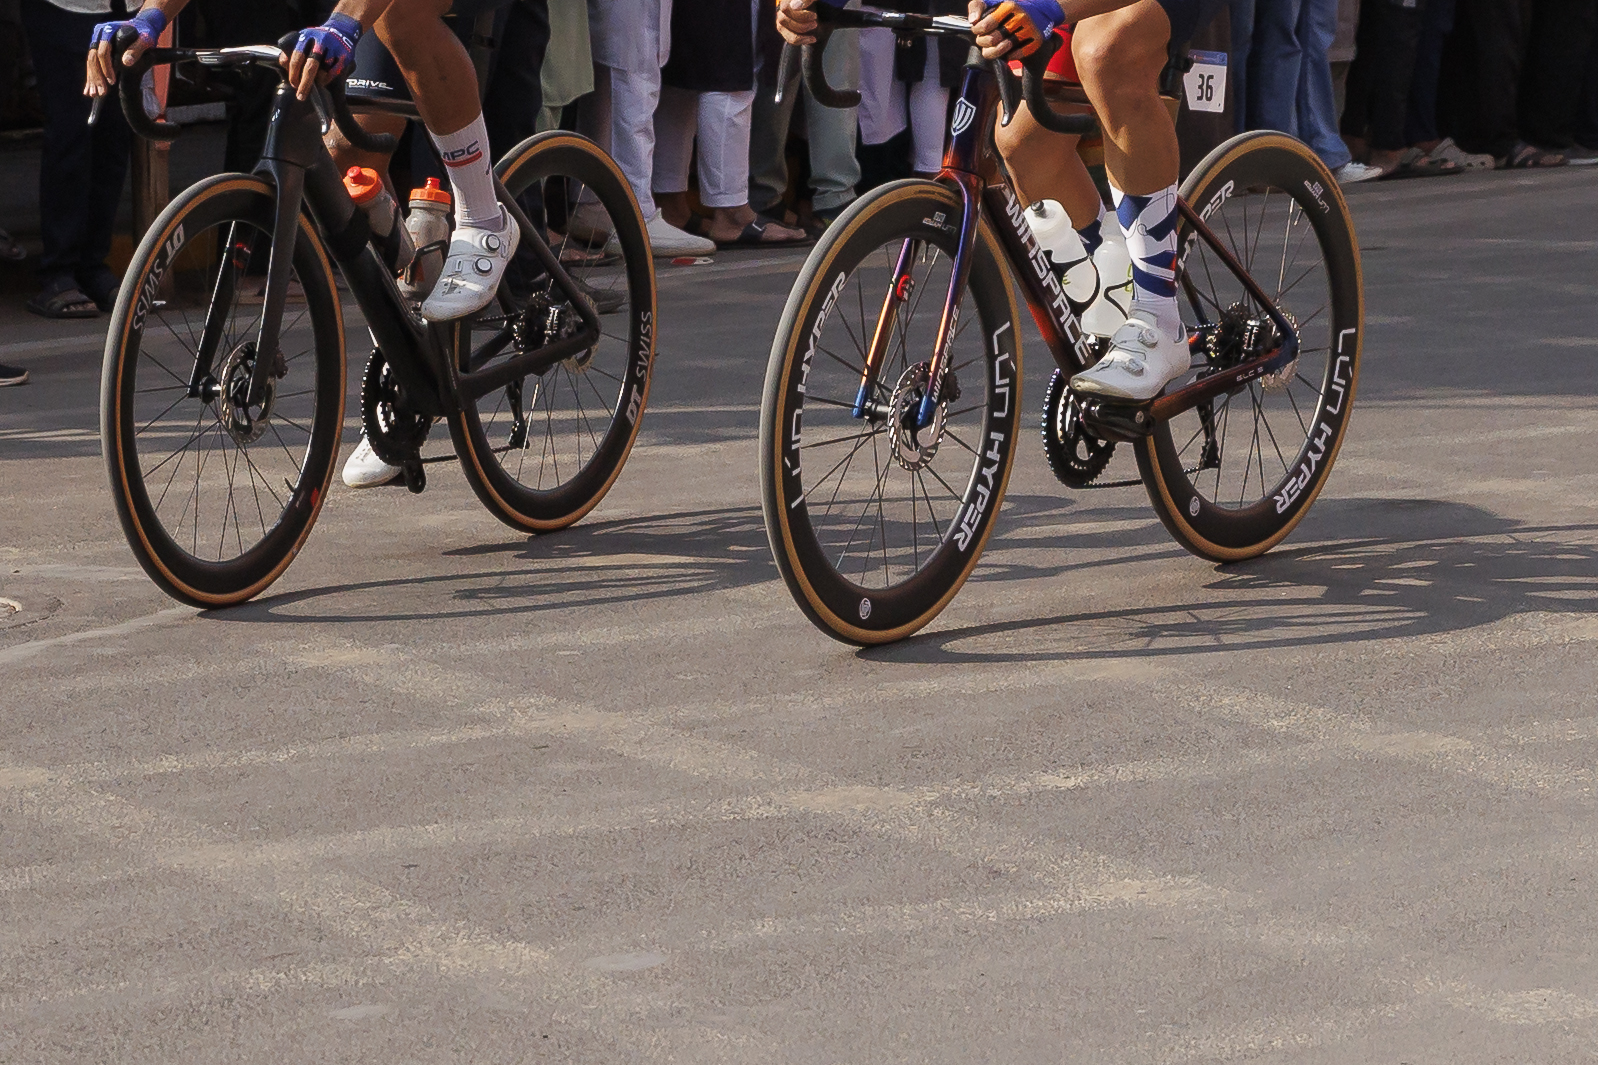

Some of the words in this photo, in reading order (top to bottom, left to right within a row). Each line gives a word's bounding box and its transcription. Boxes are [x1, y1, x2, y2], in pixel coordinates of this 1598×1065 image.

[1196, 73, 1215, 102] 36
[133, 258, 163, 331] SWISS
[165, 222, 185, 267] DT
[1005, 193, 1092, 366] WINSPACE
[626, 384, 642, 427] DT
[636, 310, 653, 382] SWISS
[798, 271, 847, 393] HYPER
[953, 431, 1006, 553] HYPER
[1273, 421, 1333, 515] HYPER
